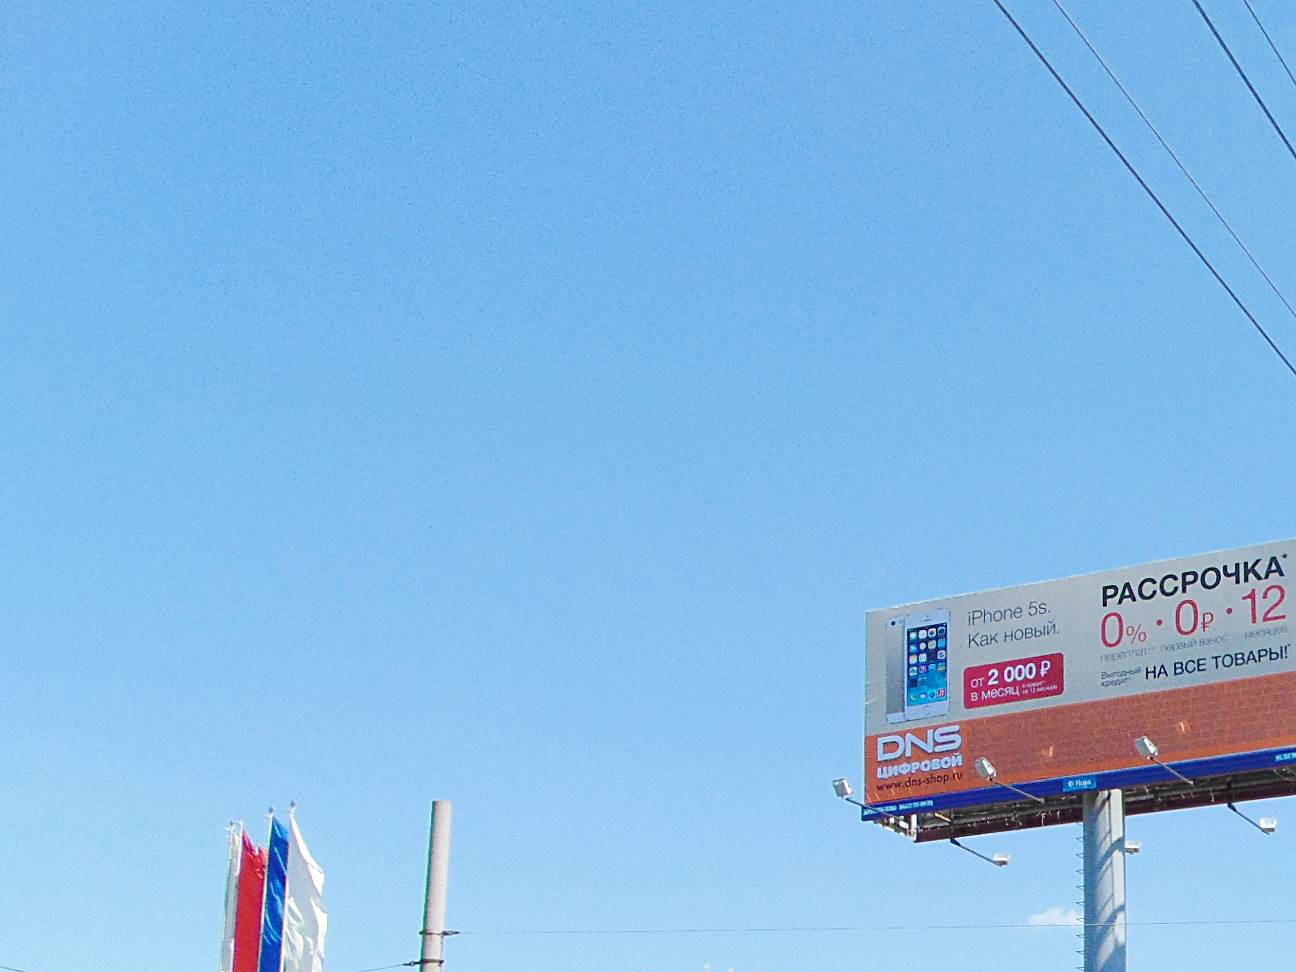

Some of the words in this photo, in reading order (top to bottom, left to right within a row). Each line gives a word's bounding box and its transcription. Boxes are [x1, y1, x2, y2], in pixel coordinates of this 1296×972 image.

[968, 606, 1023, 626] iPhone
[1028, 600, 1051, 616] 5s.
[1242, 585, 1287, 624] 12
[968, 632, 1000, 648] Как
[1004, 620, 1060, 643] новый.
[970, 677, 984, 688] от
[988, 669, 999, 685] 2
[1003, 663, 1036, 683] 000
[1145, 664, 1168, 680] НА
[1173, 658, 1207, 676] ВСЕ
[971, 692, 978, 701] в
[982, 686, 1020, 699] месяц
[877, 725, 962, 761] DNS
[876, 752, 963, 779] ЦИФРОВОЙ
[877, 771, 963, 791] www.dns-shop.ru
